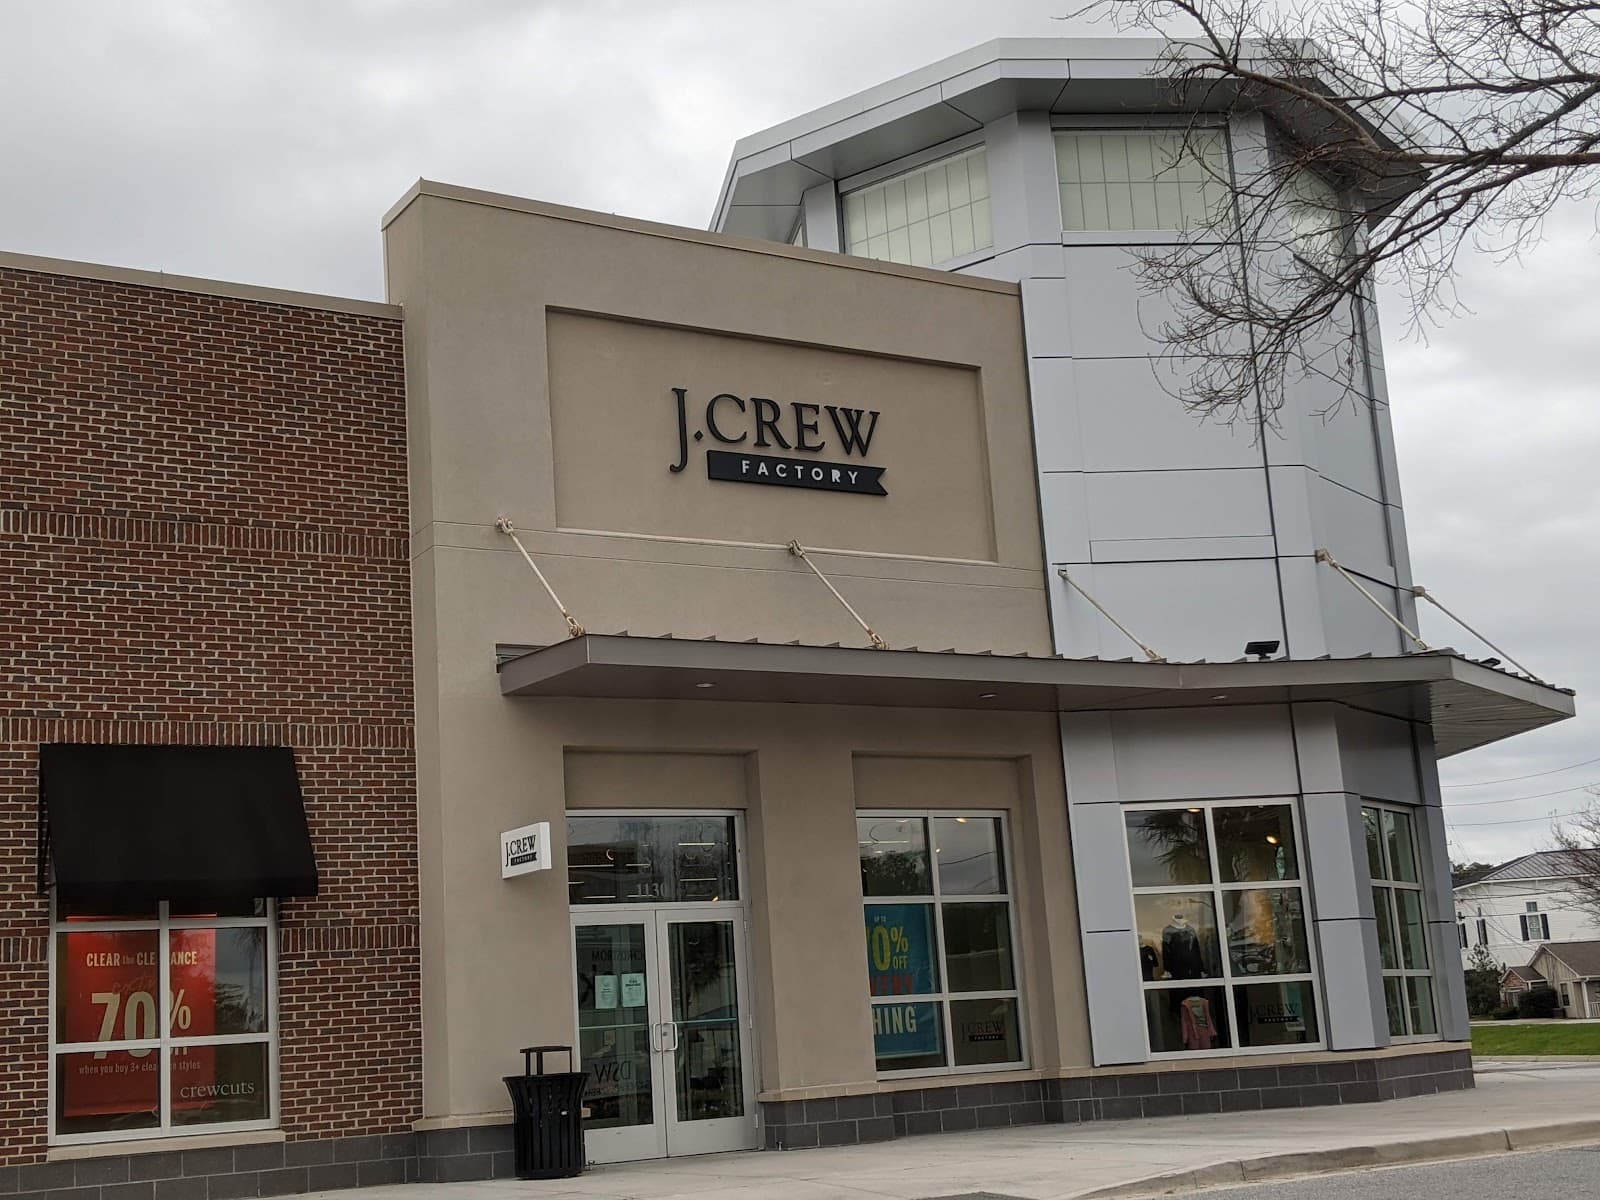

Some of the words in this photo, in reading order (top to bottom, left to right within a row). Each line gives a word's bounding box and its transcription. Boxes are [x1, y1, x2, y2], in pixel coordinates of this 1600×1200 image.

[669, 387, 881, 473] J.CREW
[741, 459, 859, 485] FACTORY
[505, 835, 537, 867] J.CREW
[86, 952, 121, 967] CLEAR
[122, 955, 135, 965] the
[136, 951, 198, 966] CLEANCE
[866, 926, 909, 971] 0%
[892, 955, 909, 969] OFF
[91, 988, 192, 1060] 70%
[79, 1064, 98, 1075] when
[100, 1065, 113, 1076] you
[115, 1063, 129, 1075] buy
[130, 1062, 140, 1072] 3+
[179, 1060, 201, 1072] styles
[179, 1082, 255, 1098] crewcuts
